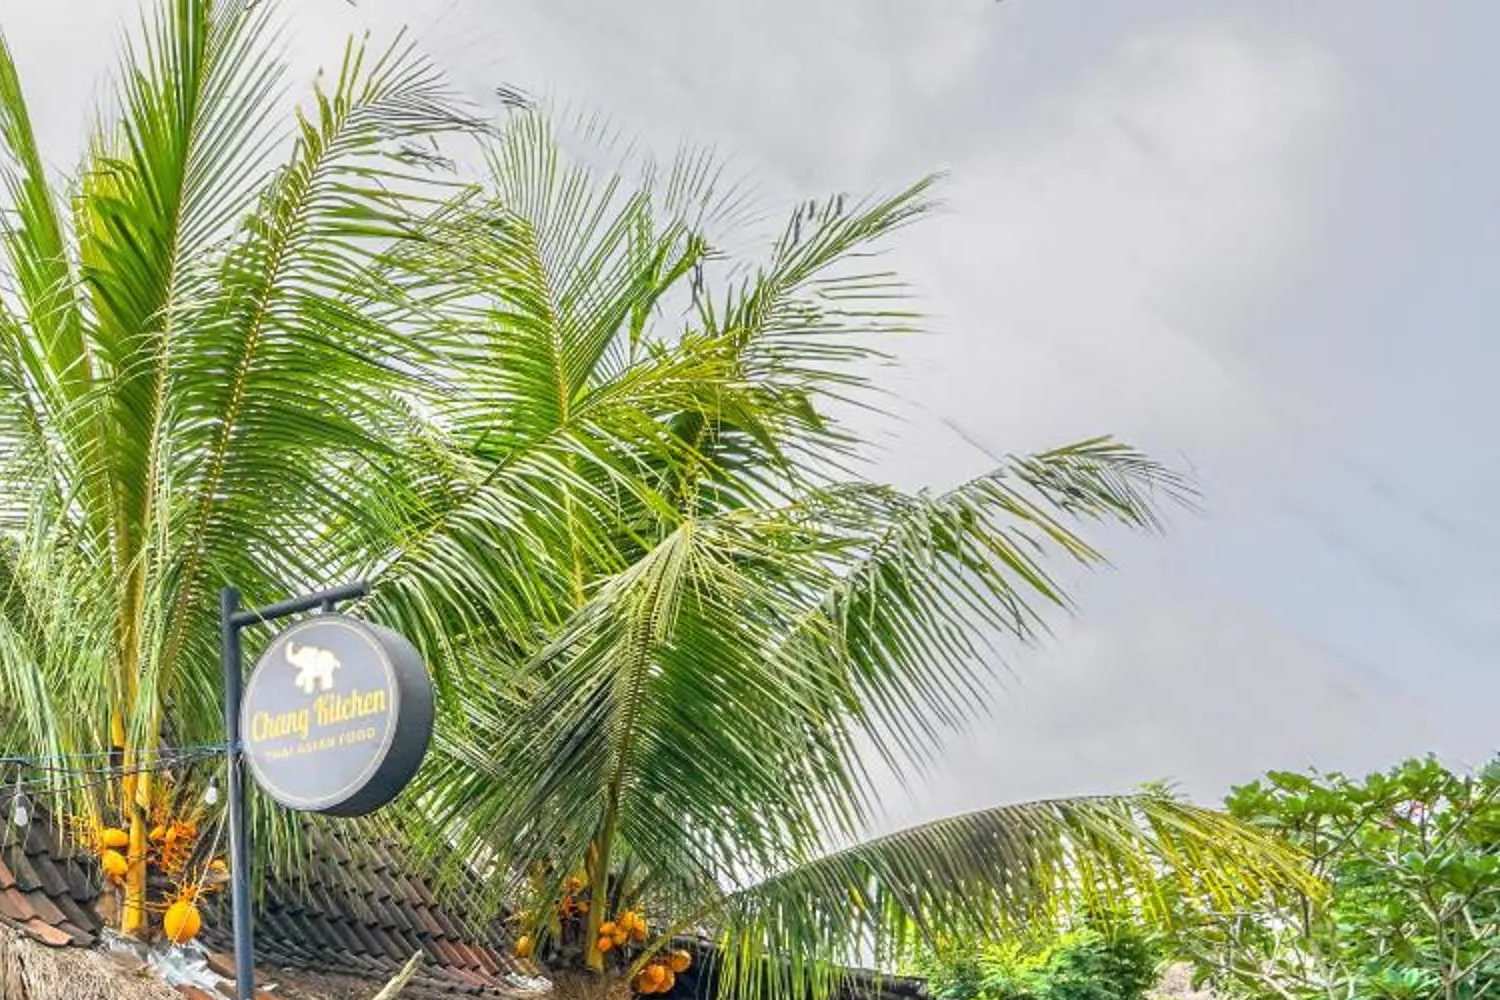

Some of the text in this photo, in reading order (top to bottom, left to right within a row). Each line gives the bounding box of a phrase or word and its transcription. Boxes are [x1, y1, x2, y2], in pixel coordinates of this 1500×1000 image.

[252, 689, 386, 742] Chang Kitchen
[340, 727, 376, 745] FOOD
